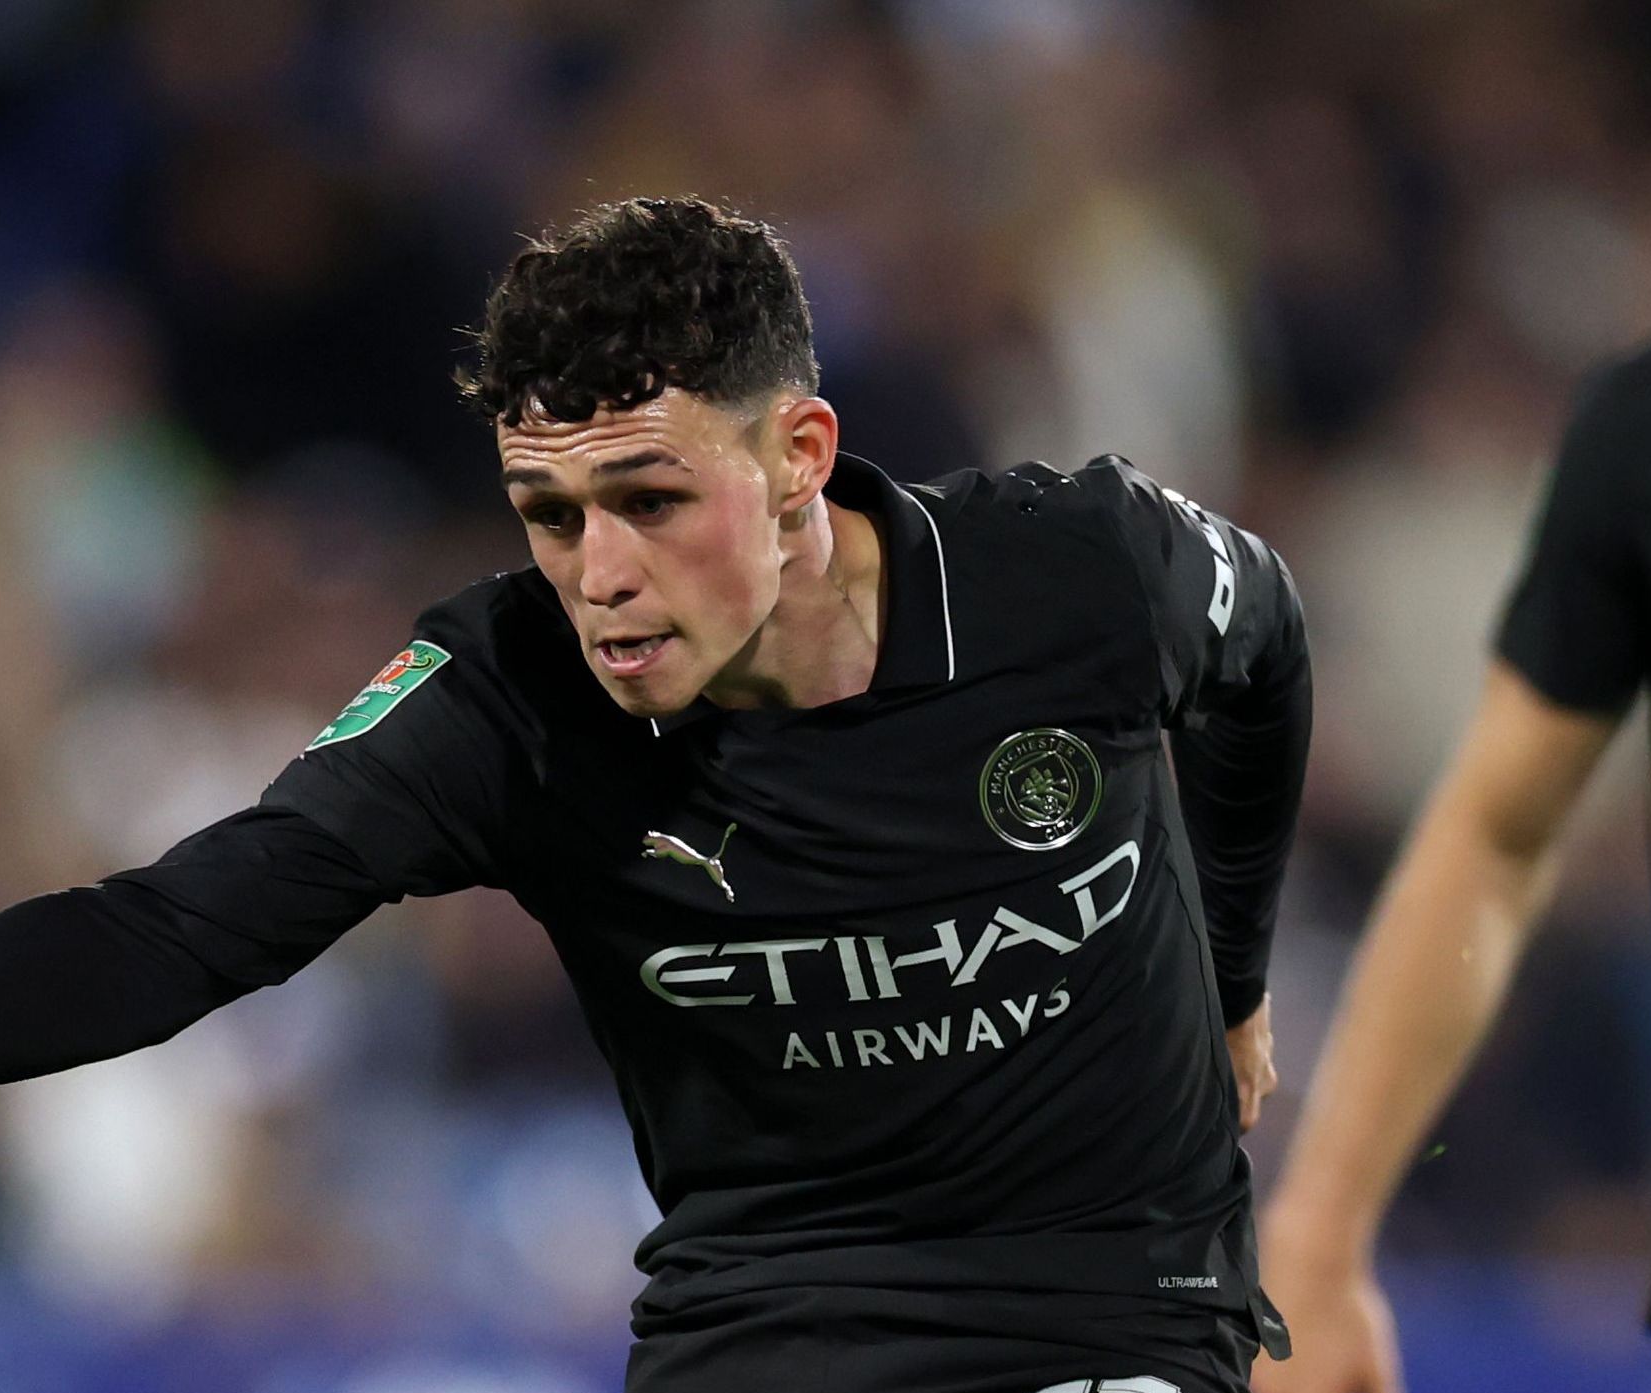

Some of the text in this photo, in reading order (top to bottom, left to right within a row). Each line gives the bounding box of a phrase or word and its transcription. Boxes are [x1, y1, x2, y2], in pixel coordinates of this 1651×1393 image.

[990, 737, 1076, 795] MANCHESTER
[1044, 816, 1075, 841] CITY
[639, 839, 1141, 1007] ETIHAD
[782, 976, 1072, 1070] AIRWAYS
